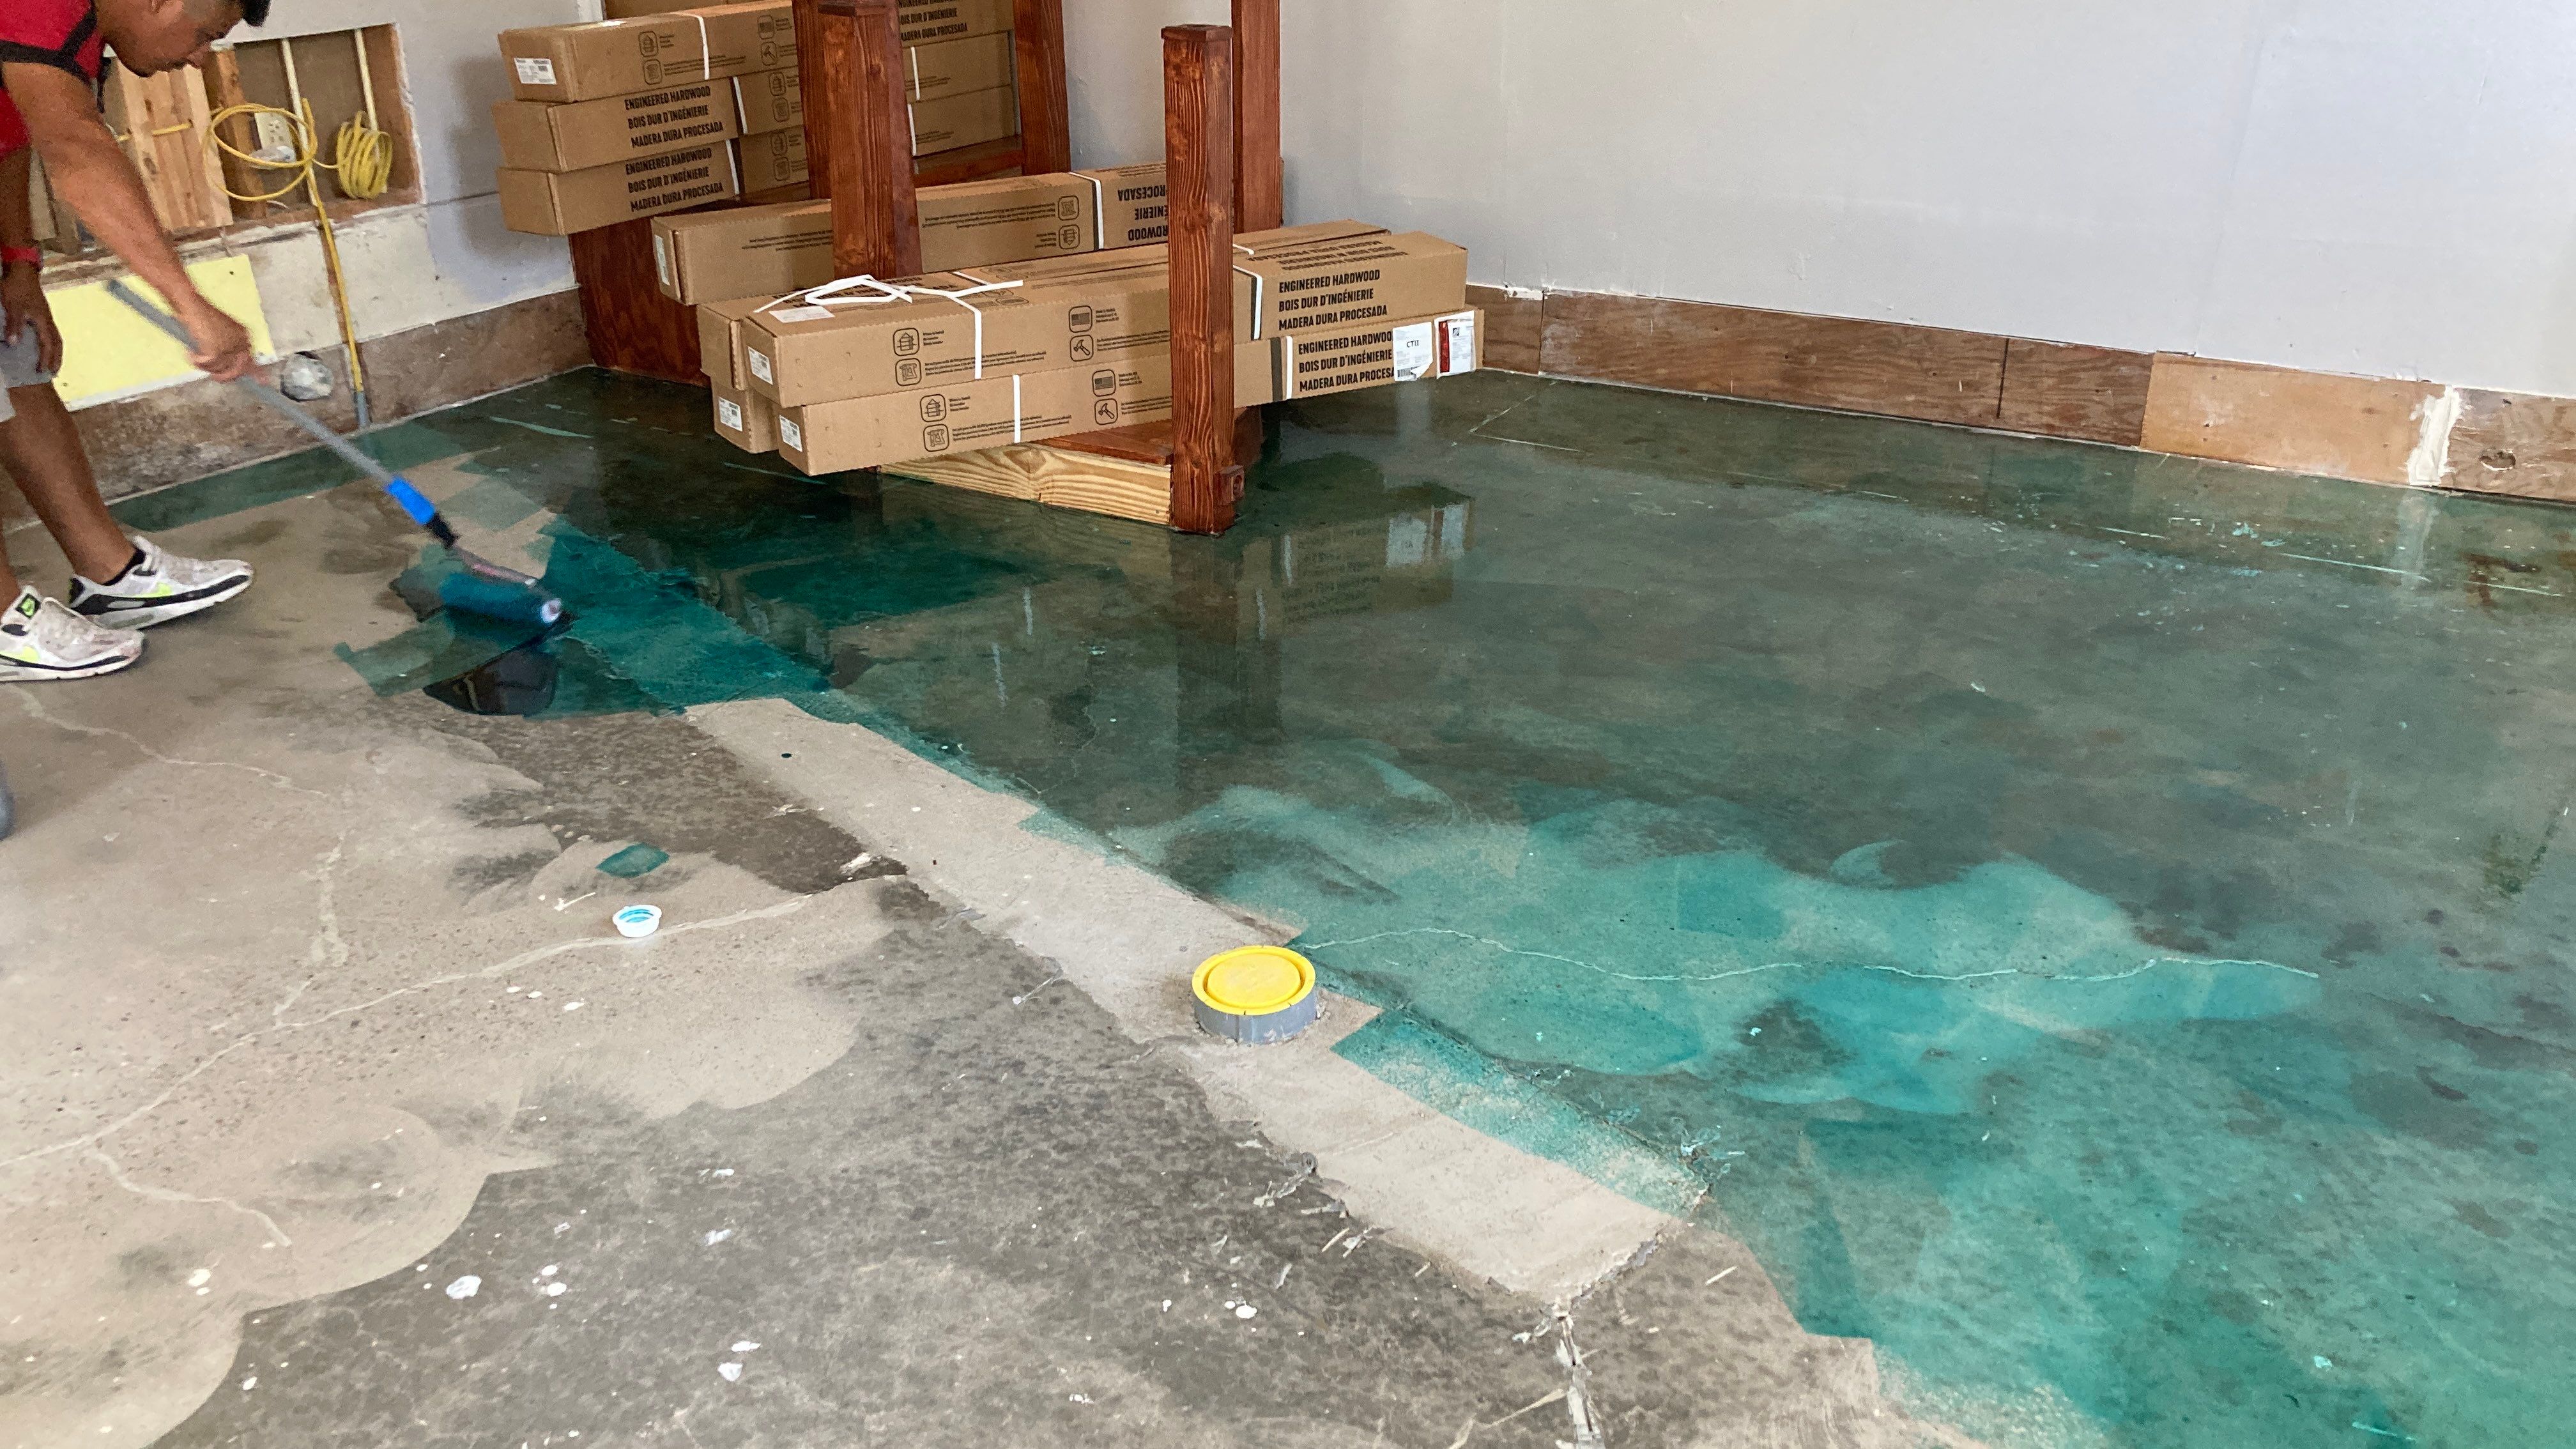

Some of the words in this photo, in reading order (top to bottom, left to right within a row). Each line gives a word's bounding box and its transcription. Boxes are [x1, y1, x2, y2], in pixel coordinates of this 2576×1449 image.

[900, 14, 910, 25] OIS
[624, 93, 670, 111] ENGINEERED
[670, 86, 711, 103] HARDWOOD
[627, 116, 646, 130] BOIS
[647, 114, 663, 126] DUR
[631, 132, 663, 148] MADERA
[663, 128, 683, 142] DURA
[683, 121, 724, 138] PROCESADA
[625, 156, 670, 175] ENGINEERED
[671, 148, 712, 165] HARDWOOD
[628, 180, 647, 194] BOIS
[647, 176, 663, 190] DUR
[630, 195, 662, 212] MADERA
[662, 192, 682, 205] DURA
[682, 182, 724, 200] PROCESADA
[1117, 185, 1165, 202] ROCESADA
[1128, 225, 1169, 241] RDWOOD
[1279, 276, 1330, 293] ENGINEERED
[1332, 269, 1380, 286] HARDWOOD
[1278, 299, 1299, 312] BOIS
[1301, 296, 1318, 309] DUR
[1320, 288, 1374, 306] D'INGÉNIERIE
[1278, 316, 1314, 331] MADERA
[1315, 312, 1338, 325] DURA
[1340, 305, 1387, 322] PROCESADA
[1298, 337, 1349, 355] ENGINEERED
[1351, 330, 1393, 347] HARDWOO
[1299, 360, 1319, 373] BOIS
[1321, 357, 1338, 371] DUR
[1340, 349, 1392, 367] D'INGÉNIERIE
[1300, 376, 1335, 392] MADERA
[1336, 372, 1358, 386] DURA
[1360, 367, 1394, 382] PROCESA
